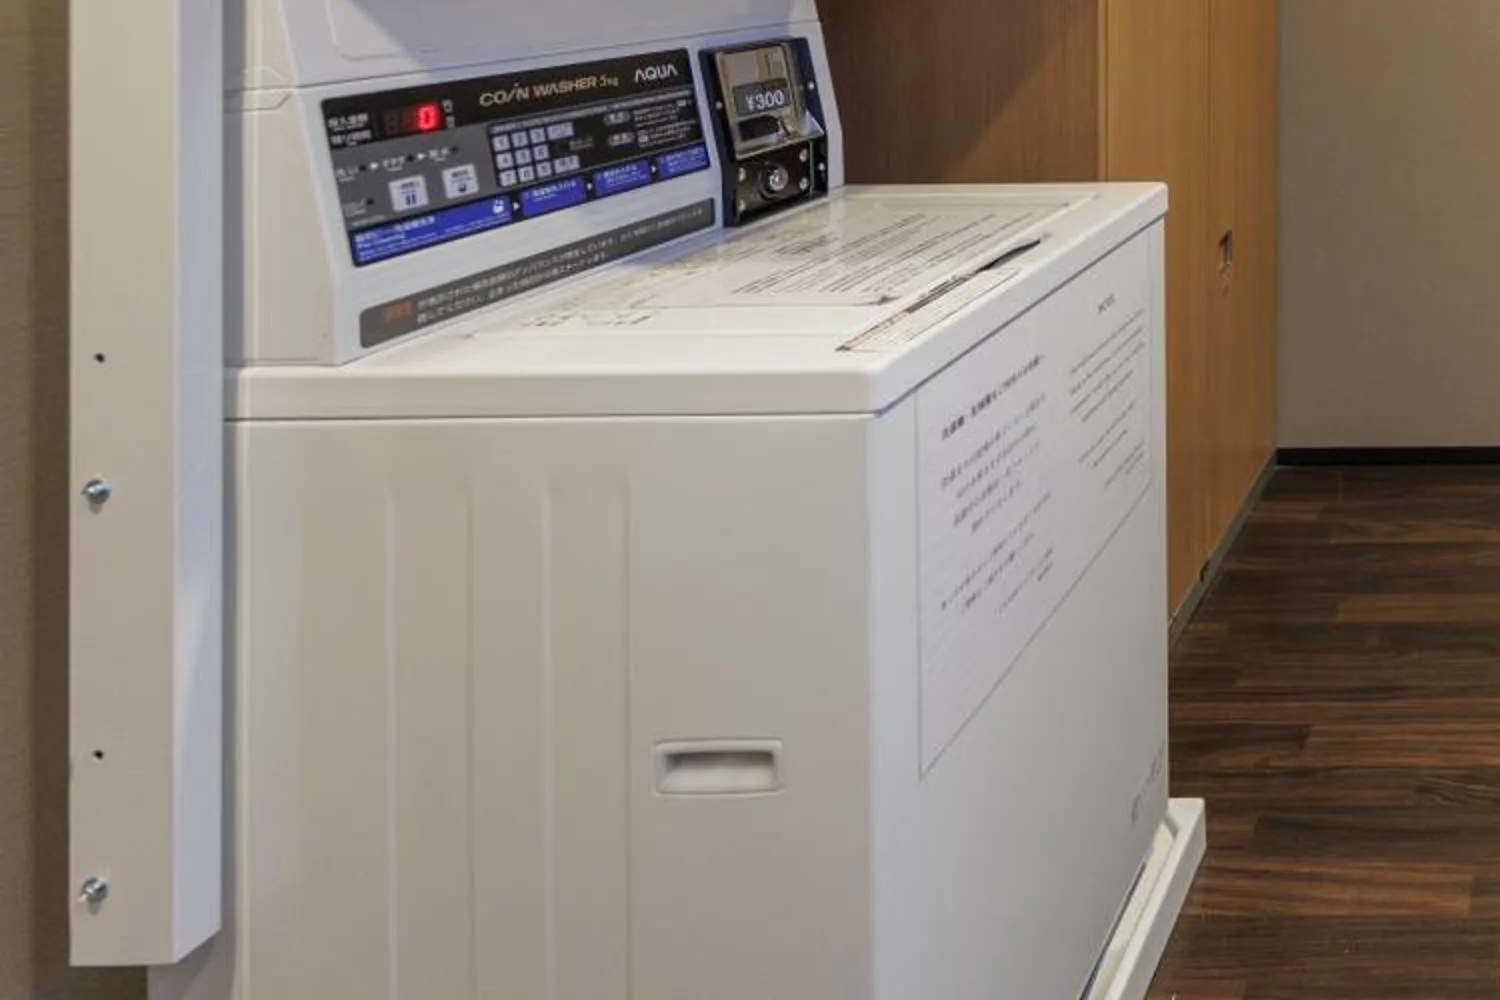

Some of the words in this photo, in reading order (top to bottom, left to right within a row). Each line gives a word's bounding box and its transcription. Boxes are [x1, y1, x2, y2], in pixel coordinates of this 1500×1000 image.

[634, 63, 679, 84] AQUA
[532, 75, 599, 98] WASHER
[745, 89, 785, 110] ¥300
[416, 104, 438, 130] 0
